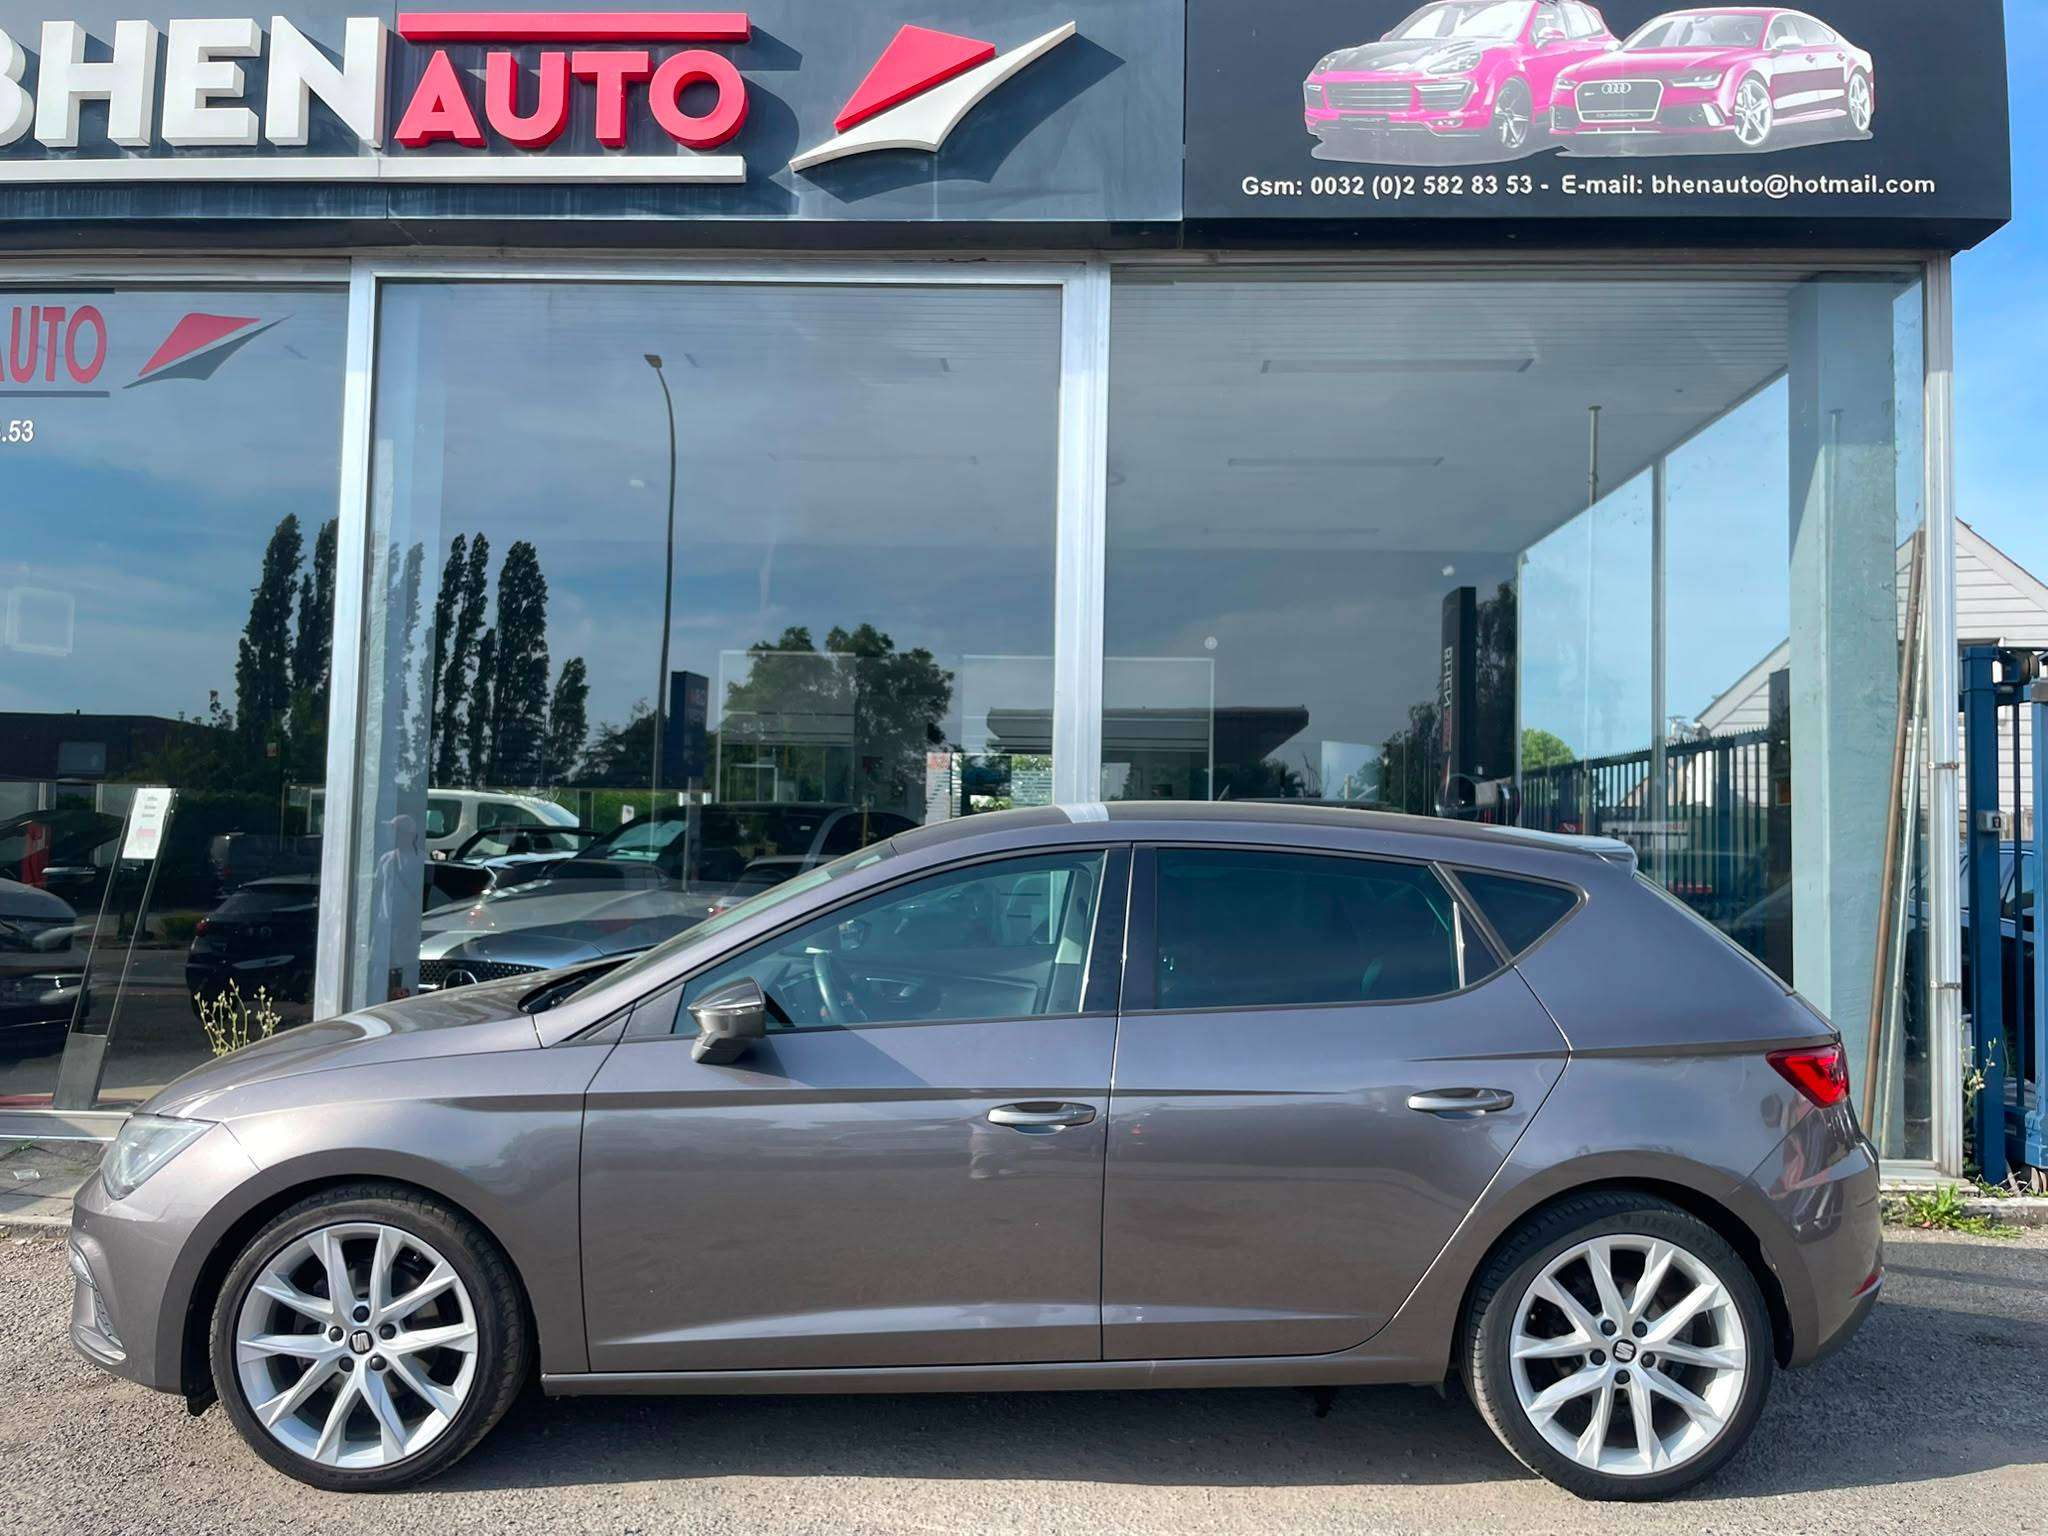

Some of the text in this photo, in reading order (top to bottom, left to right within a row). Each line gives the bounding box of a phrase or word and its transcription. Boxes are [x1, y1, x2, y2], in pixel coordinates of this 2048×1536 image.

[393, 49, 749, 150] AUTO
[1241, 175, 1303, 195] Gsm:
[1310, 175, 1365, 195] 0032
[1372, 175, 1415, 199] (0)2
[1422, 175, 1464, 195] 582
[1471, 175, 1498, 195] 83
[1505, 174, 1532, 194] 53
[1561, 174, 1642, 194] E-mail:
[1651, 173, 1935, 198] bhenauto@hotmail.com
[0, 305, 108, 384] UTO
[0, 419, 34, 443] .53
